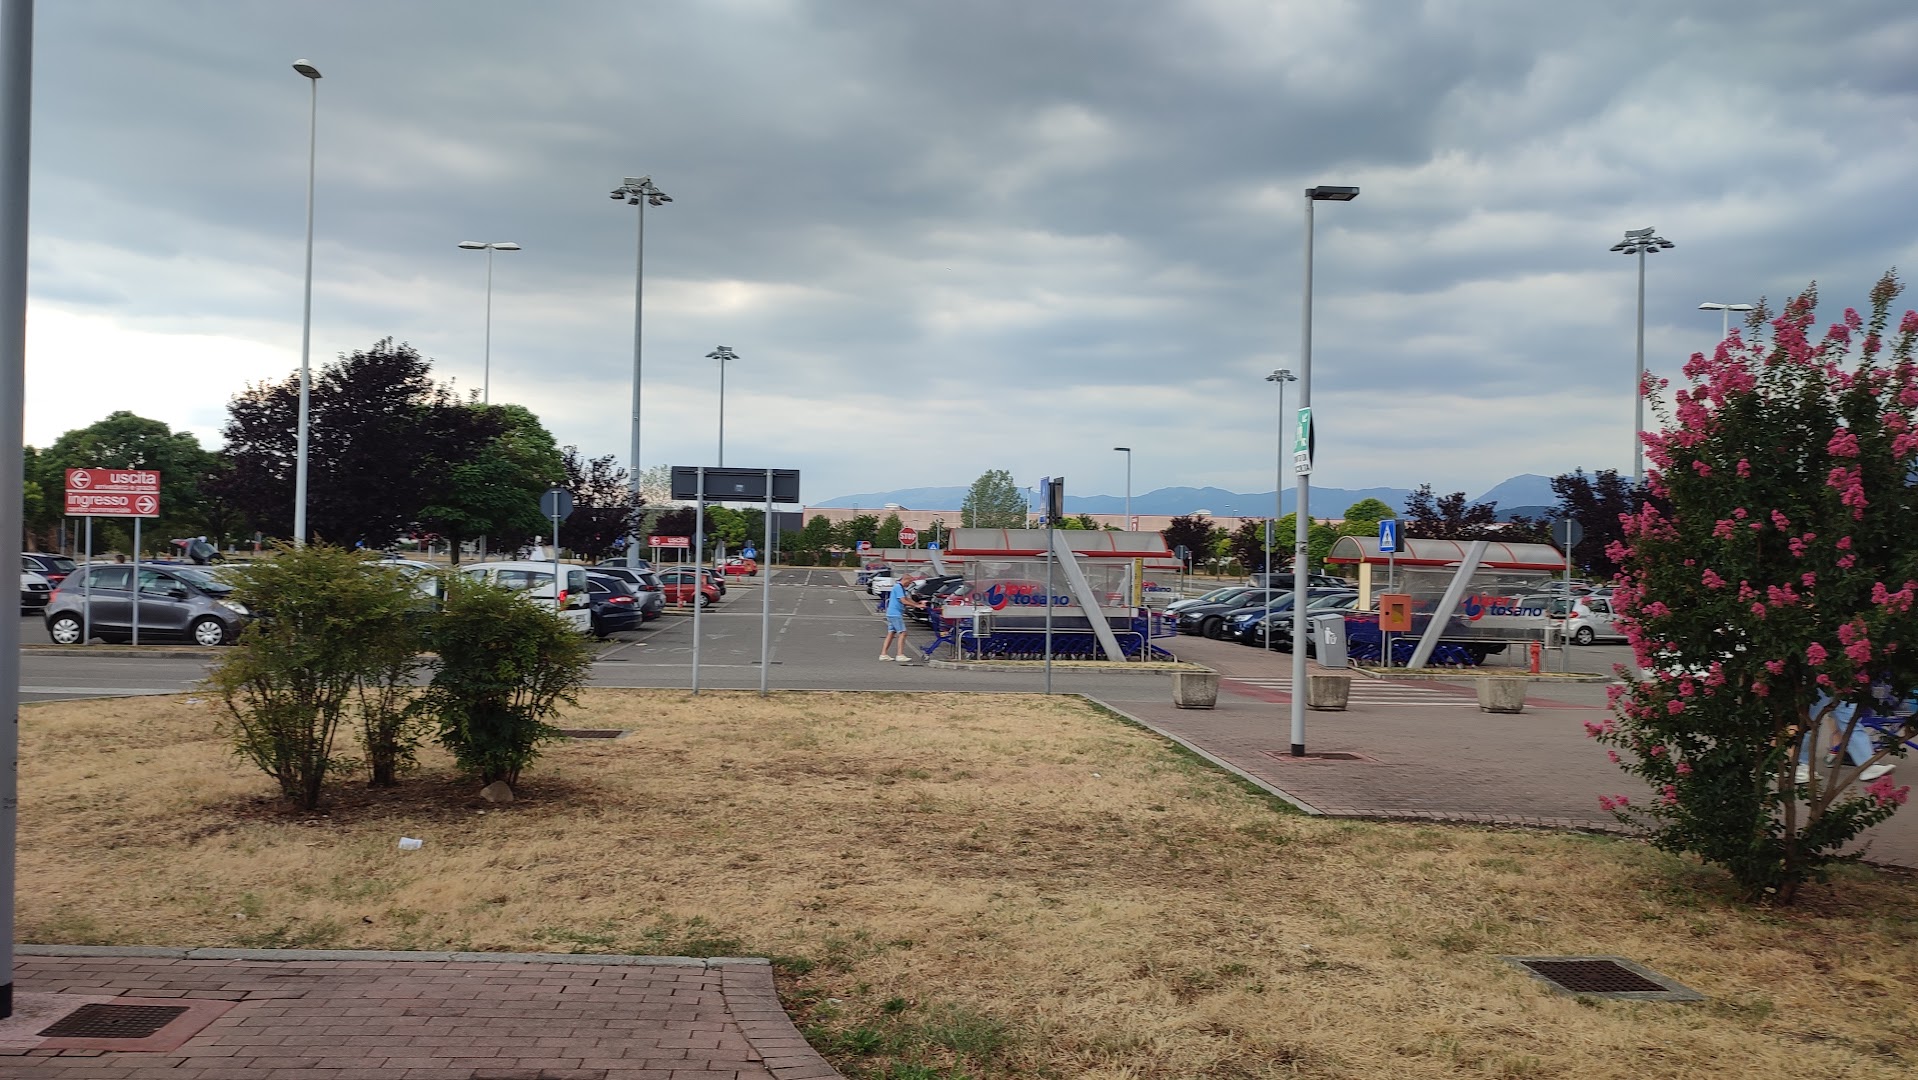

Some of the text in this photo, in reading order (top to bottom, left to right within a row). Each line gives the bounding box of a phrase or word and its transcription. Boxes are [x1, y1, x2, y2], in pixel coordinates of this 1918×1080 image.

[110, 472, 156, 484] uscita
[67, 492, 129, 508] ingresso
[1014, 590, 1070, 605] tosano
[1489, 602, 1543, 617] tosano
